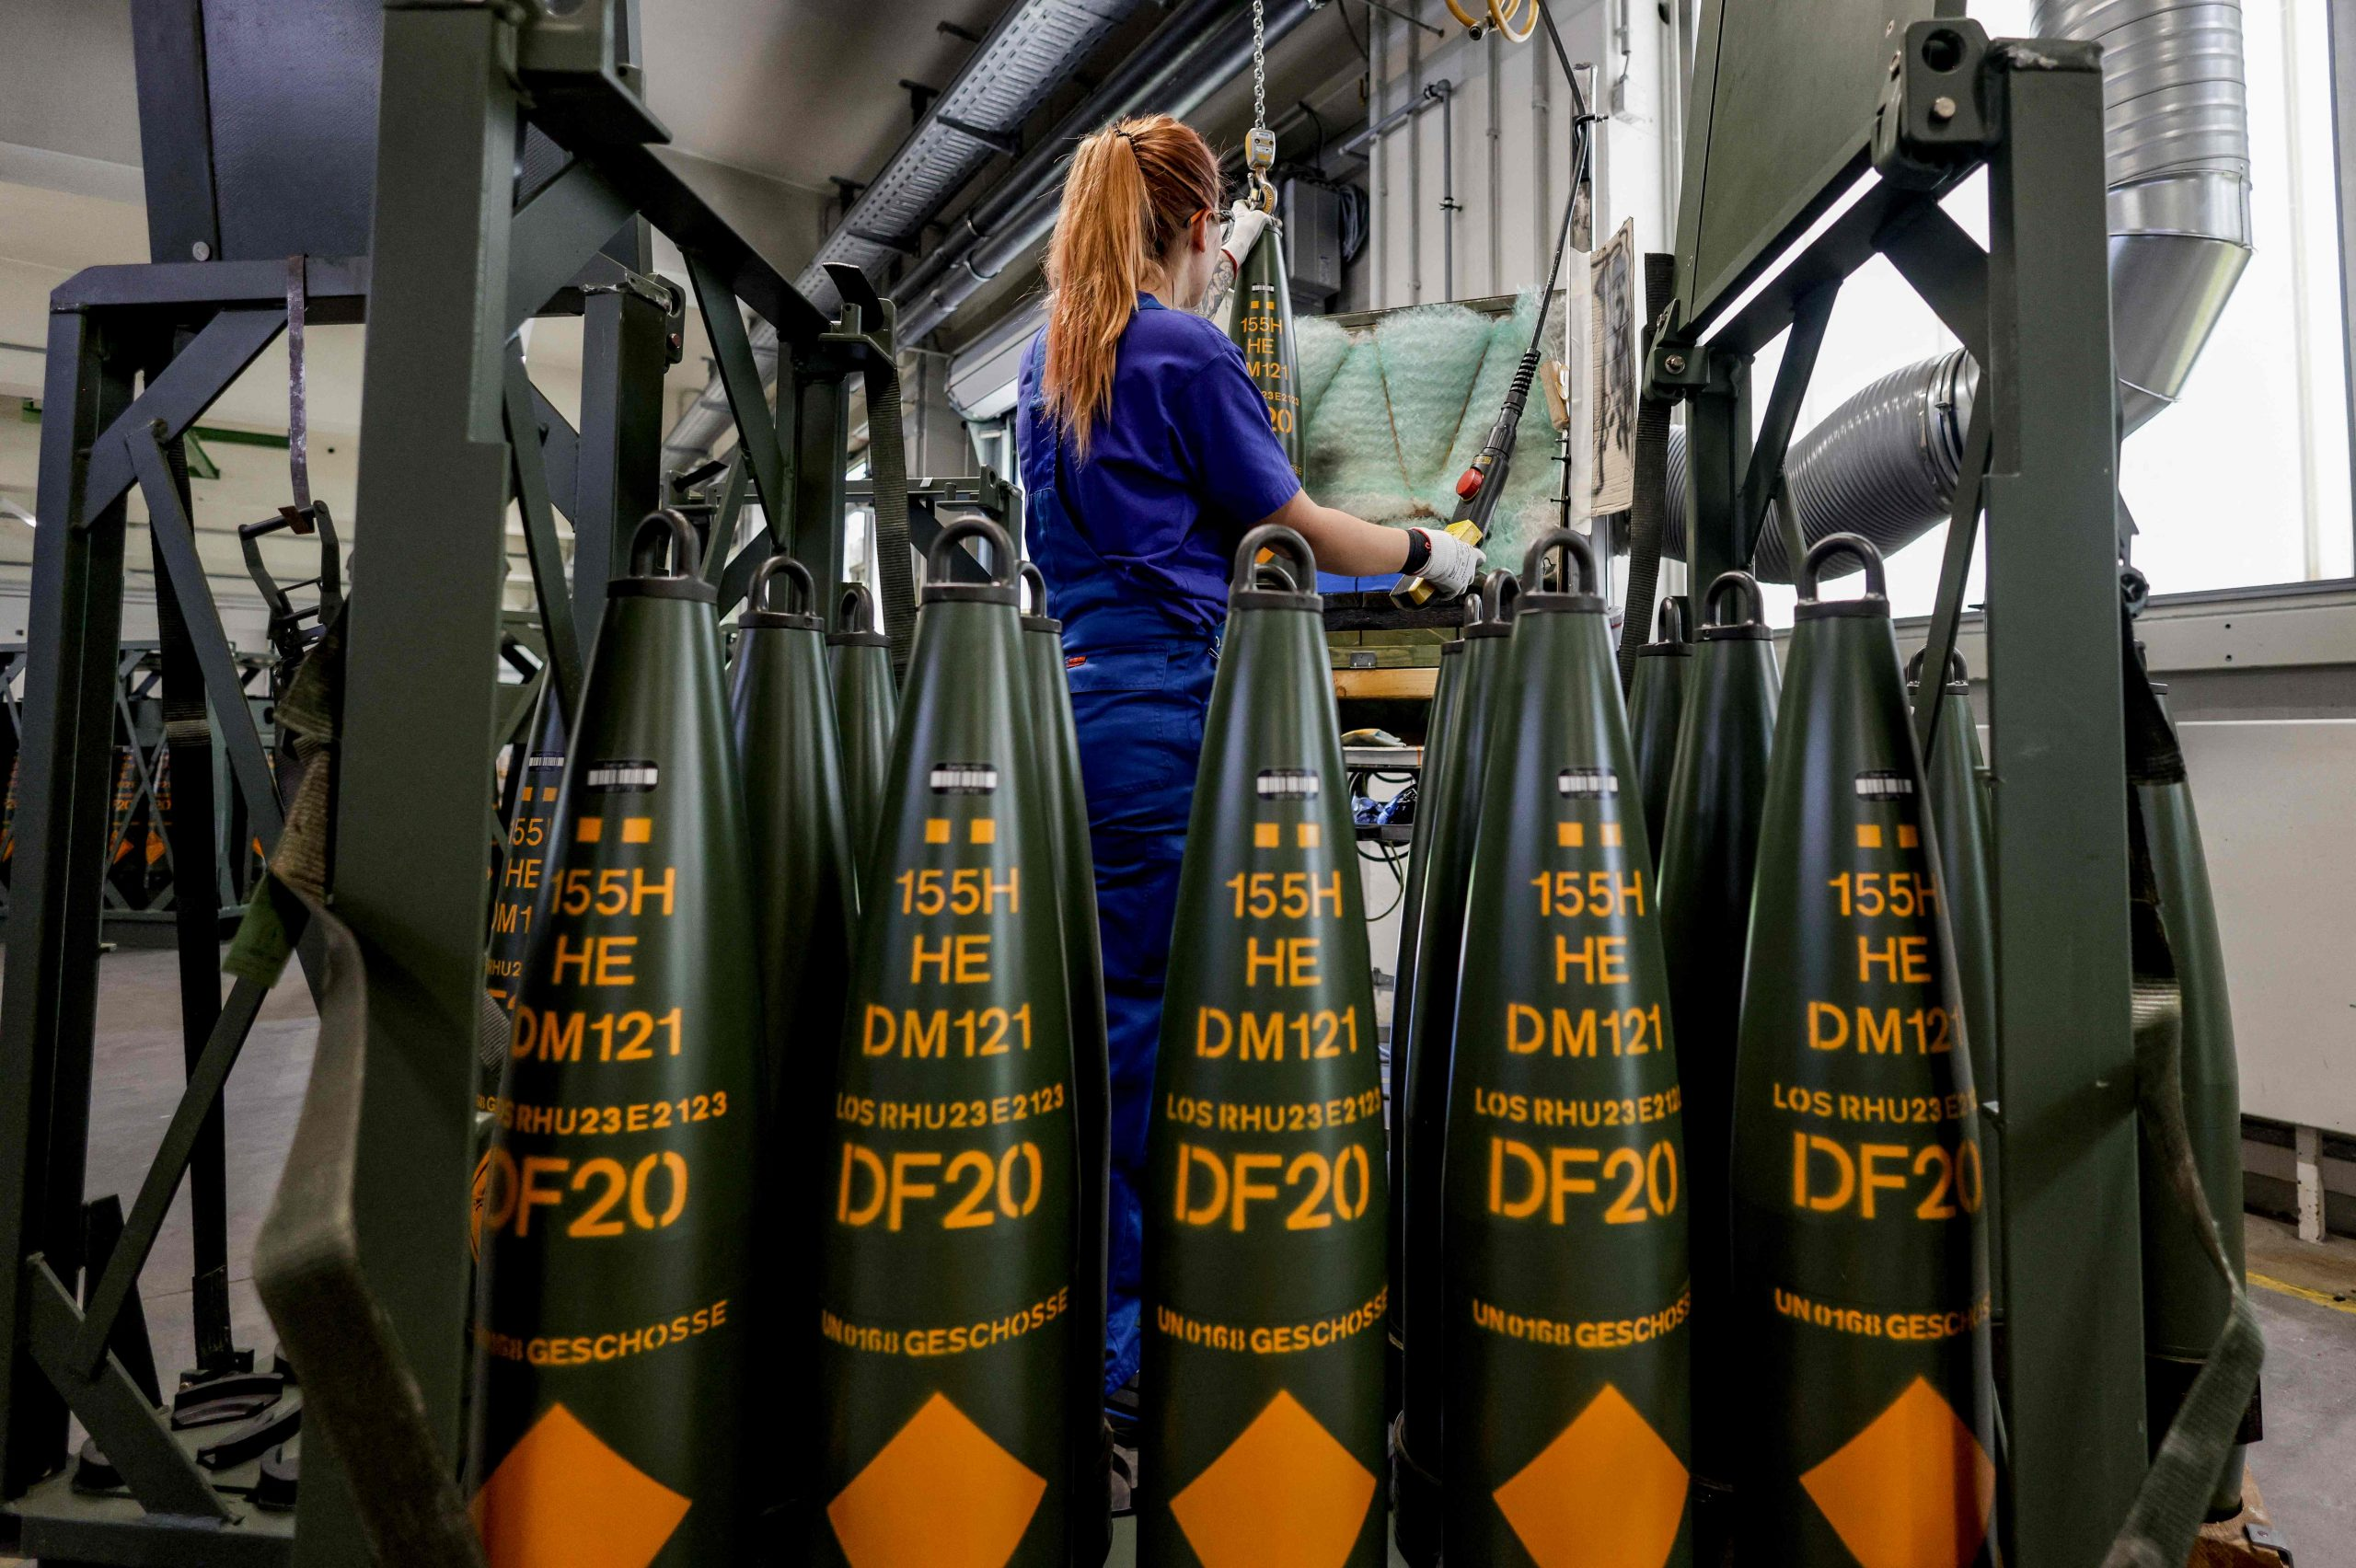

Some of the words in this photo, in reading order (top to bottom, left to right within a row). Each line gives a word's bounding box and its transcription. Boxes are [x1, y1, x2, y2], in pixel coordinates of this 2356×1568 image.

[1242, 317, 1283, 334] 155H
[1248, 338, 1274, 354] HE
[1246, 362, 1288, 380] M121
[505, 859, 542, 888] HE
[551, 868, 676, 916] 155H
[896, 868, 1020, 915] 155H
[1226, 870, 1342, 918] 155H
[1531, 870, 1644, 917] 155H
[1829, 871, 1942, 917] 155H
[553, 935, 638, 986] HE
[911, 935, 991, 984] HE
[1246, 937, 1322, 986] HE
[1556, 935, 1629, 985] HE
[1858, 936, 1931, 983] HE
[512, 1008, 682, 1062] DM121
[863, 1004, 1031, 1058] DM121
[1196, 1005, 1357, 1061] DM121
[1507, 1003, 1662, 1057] DM121
[1167, 1093, 1213, 1128] LOS
[1475, 1088, 1528, 1122] LOS
[1773, 1082, 1833, 1116] LOS
[837, 1142, 1042, 1231] DF20
[1175, 1144, 1369, 1232] DF20
[1489, 1136, 1678, 1225] DF20
[1795, 1131, 1982, 1219] DF20
[526, 1300, 728, 1366] GESCHOSSE
[905, 1286, 1068, 1357] GESCHOSSE
